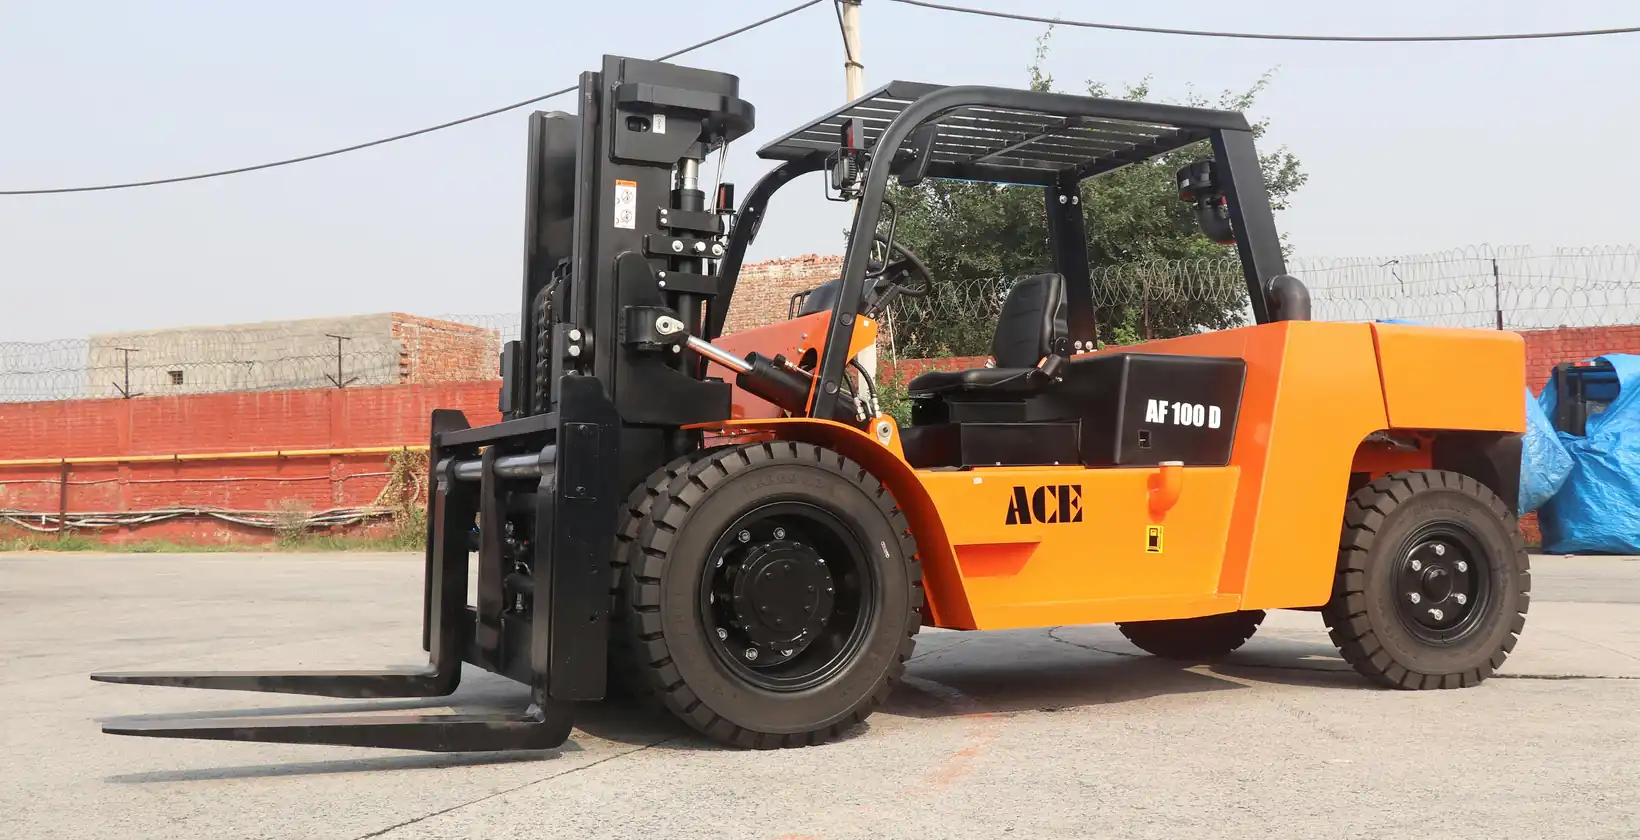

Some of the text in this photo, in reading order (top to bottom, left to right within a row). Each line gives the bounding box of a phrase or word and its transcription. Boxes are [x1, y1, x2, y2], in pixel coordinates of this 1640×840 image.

[1145, 399, 1221, 429] AF 100 D
[1005, 485, 1083, 525] ACE
